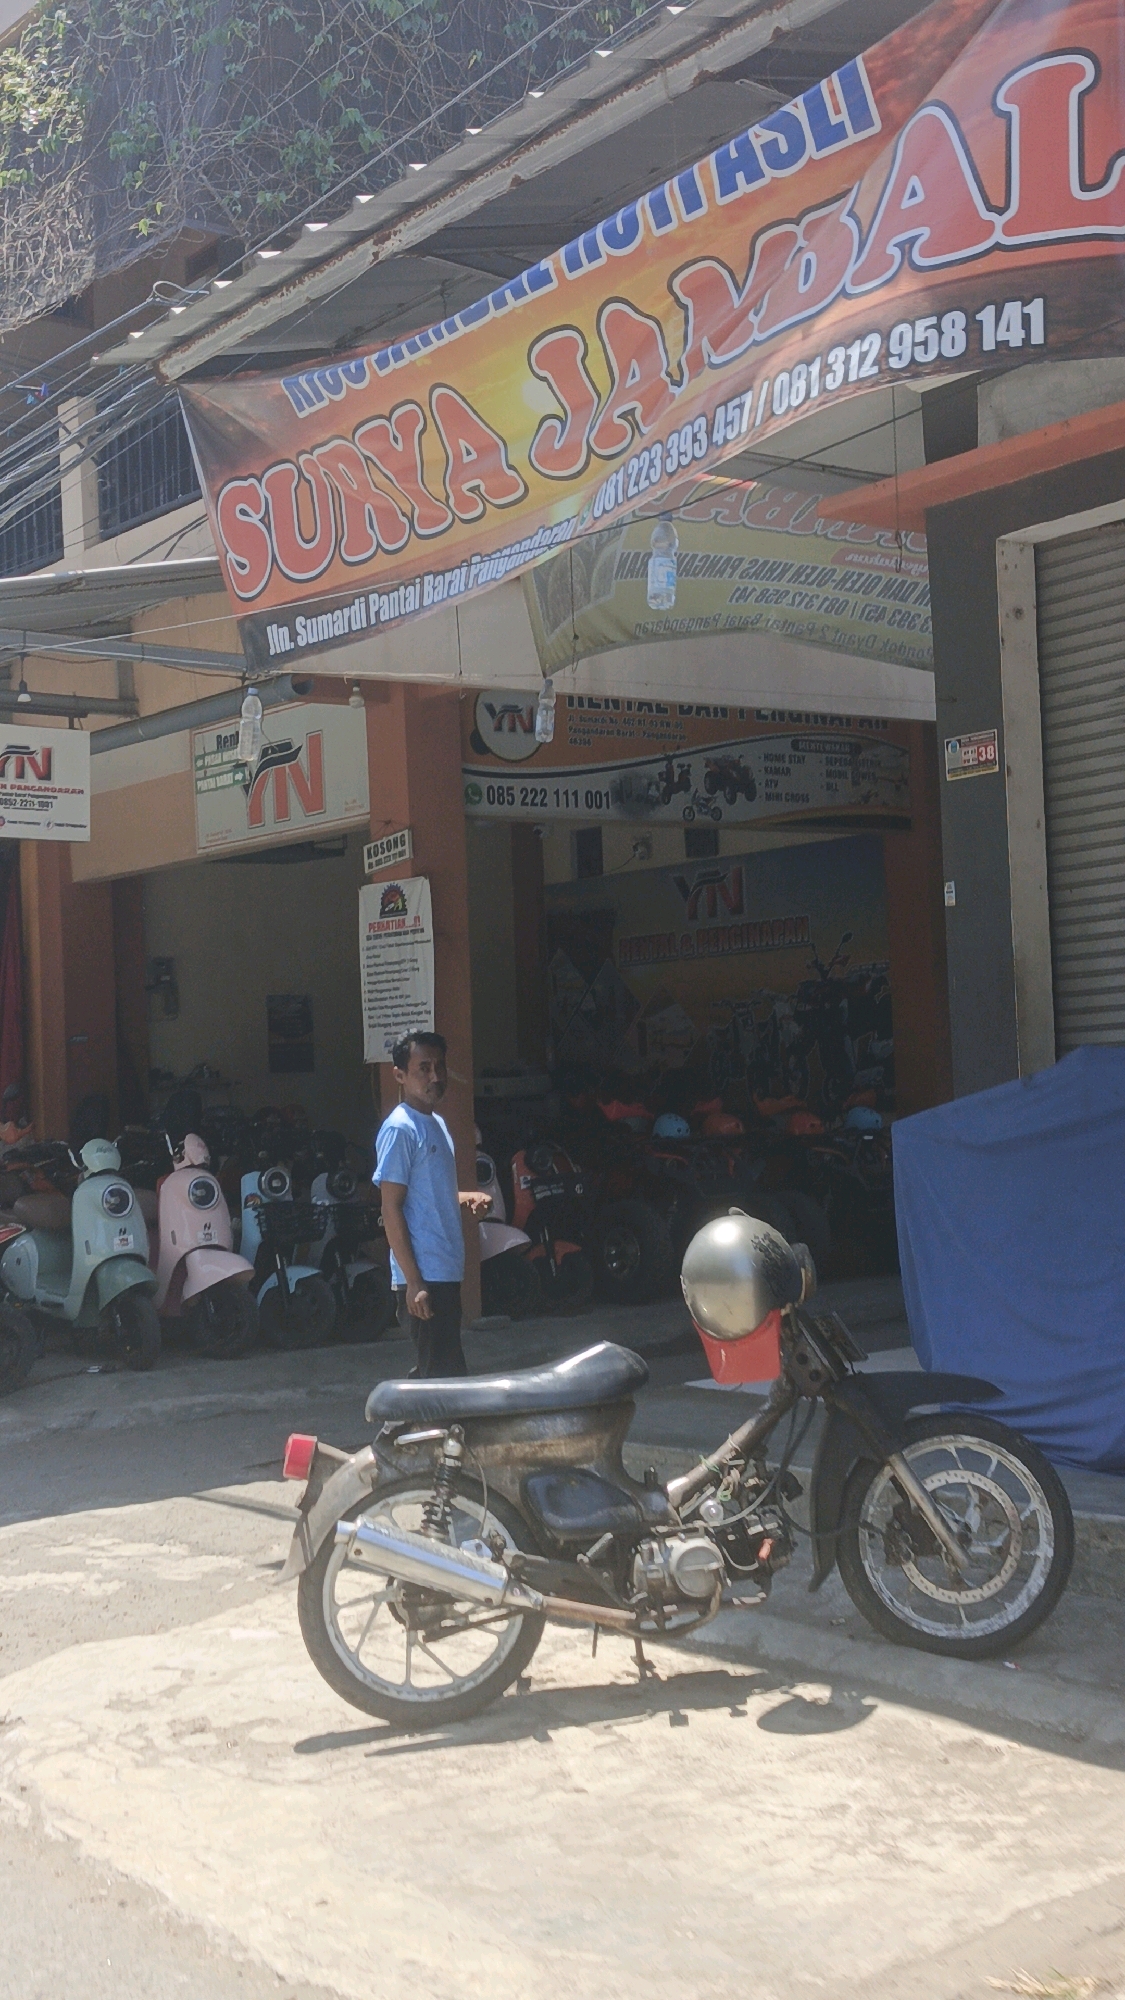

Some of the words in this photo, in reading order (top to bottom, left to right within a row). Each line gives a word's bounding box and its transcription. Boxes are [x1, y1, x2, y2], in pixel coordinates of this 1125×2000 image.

[710, 54, 881, 205] ASLI
[217, 384, 526, 598] SURYA
[266, 622, 295, 656] Jln.
[295, 597, 367, 647] Sumardi
[369, 578, 421, 625] Pantai
[423, 563, 470, 608] Barat
[592, 461, 625, 518] 081
[627, 442, 662, 499] 223
[665, 416, 708, 476] 393
[712, 393, 752, 447] 457
[772, 360, 820, 416] 081
[826, 333, 882, 391] 312
[888, 310, 968, 370] 958
[975, 297, 1045, 352] 141
[366, 833, 406, 860] KOSONG
[486, 784, 516, 806] 085
[519, 786, 548, 808] 222
[553, 788, 580, 809] 111
[584, 789, 612, 811] 001
